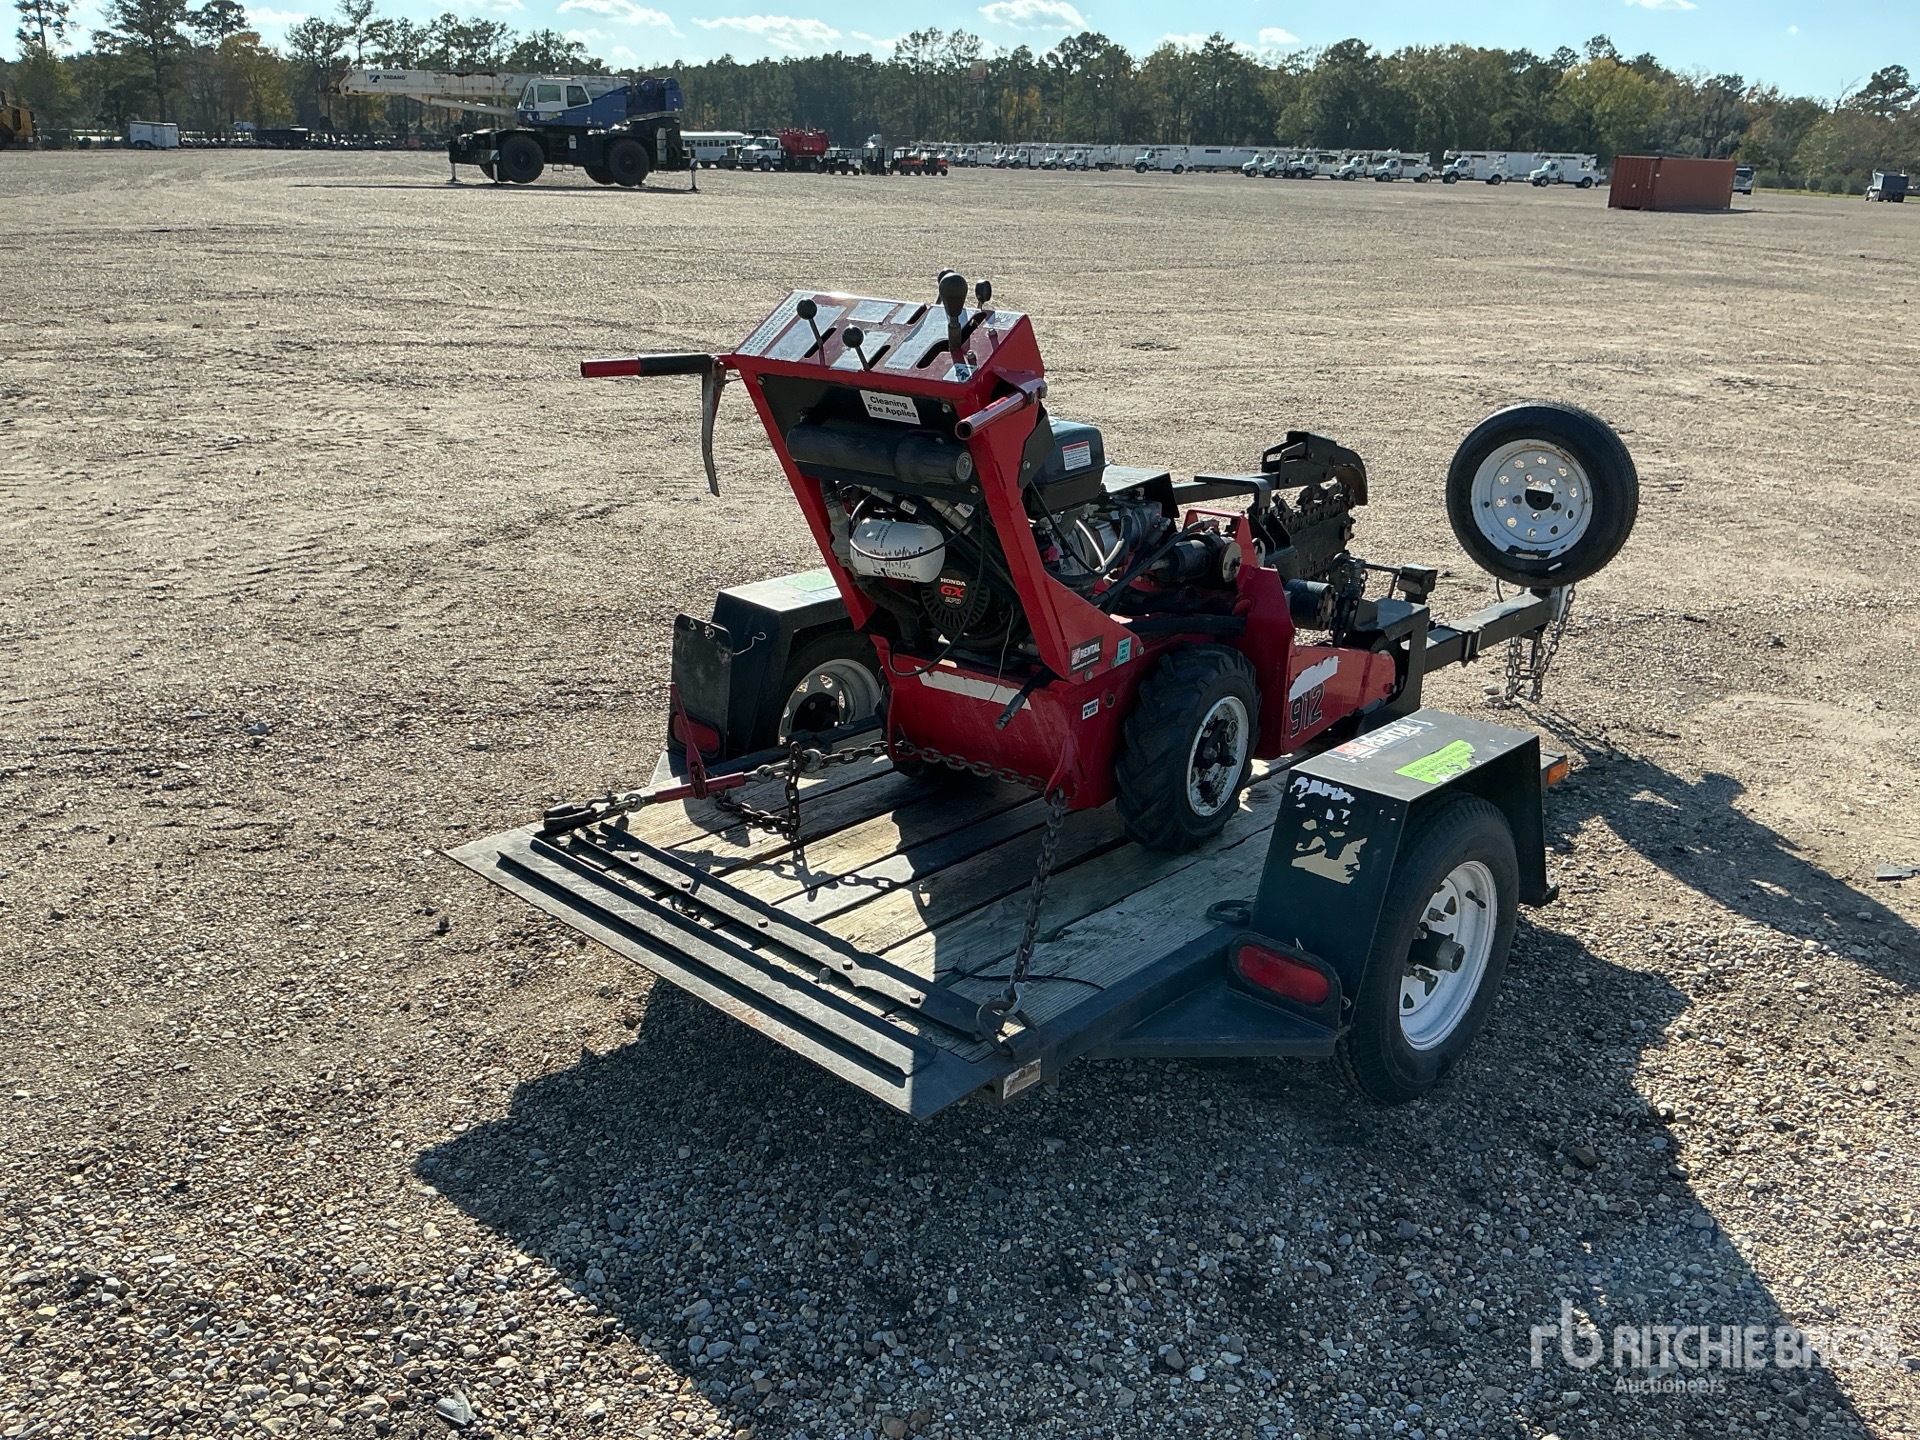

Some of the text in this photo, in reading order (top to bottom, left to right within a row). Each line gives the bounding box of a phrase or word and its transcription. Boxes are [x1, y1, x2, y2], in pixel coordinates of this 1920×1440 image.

[870, 395, 908, 410] Cleaning
[867, 403, 917, 418] Fee Applies
[940, 577, 967, 587] HONDA
[940, 586, 965, 598] GX
[1080, 643, 1100, 658] RENTAL
[1290, 683, 1325, 739] 912
[1361, 724, 1423, 747] RENTAL
